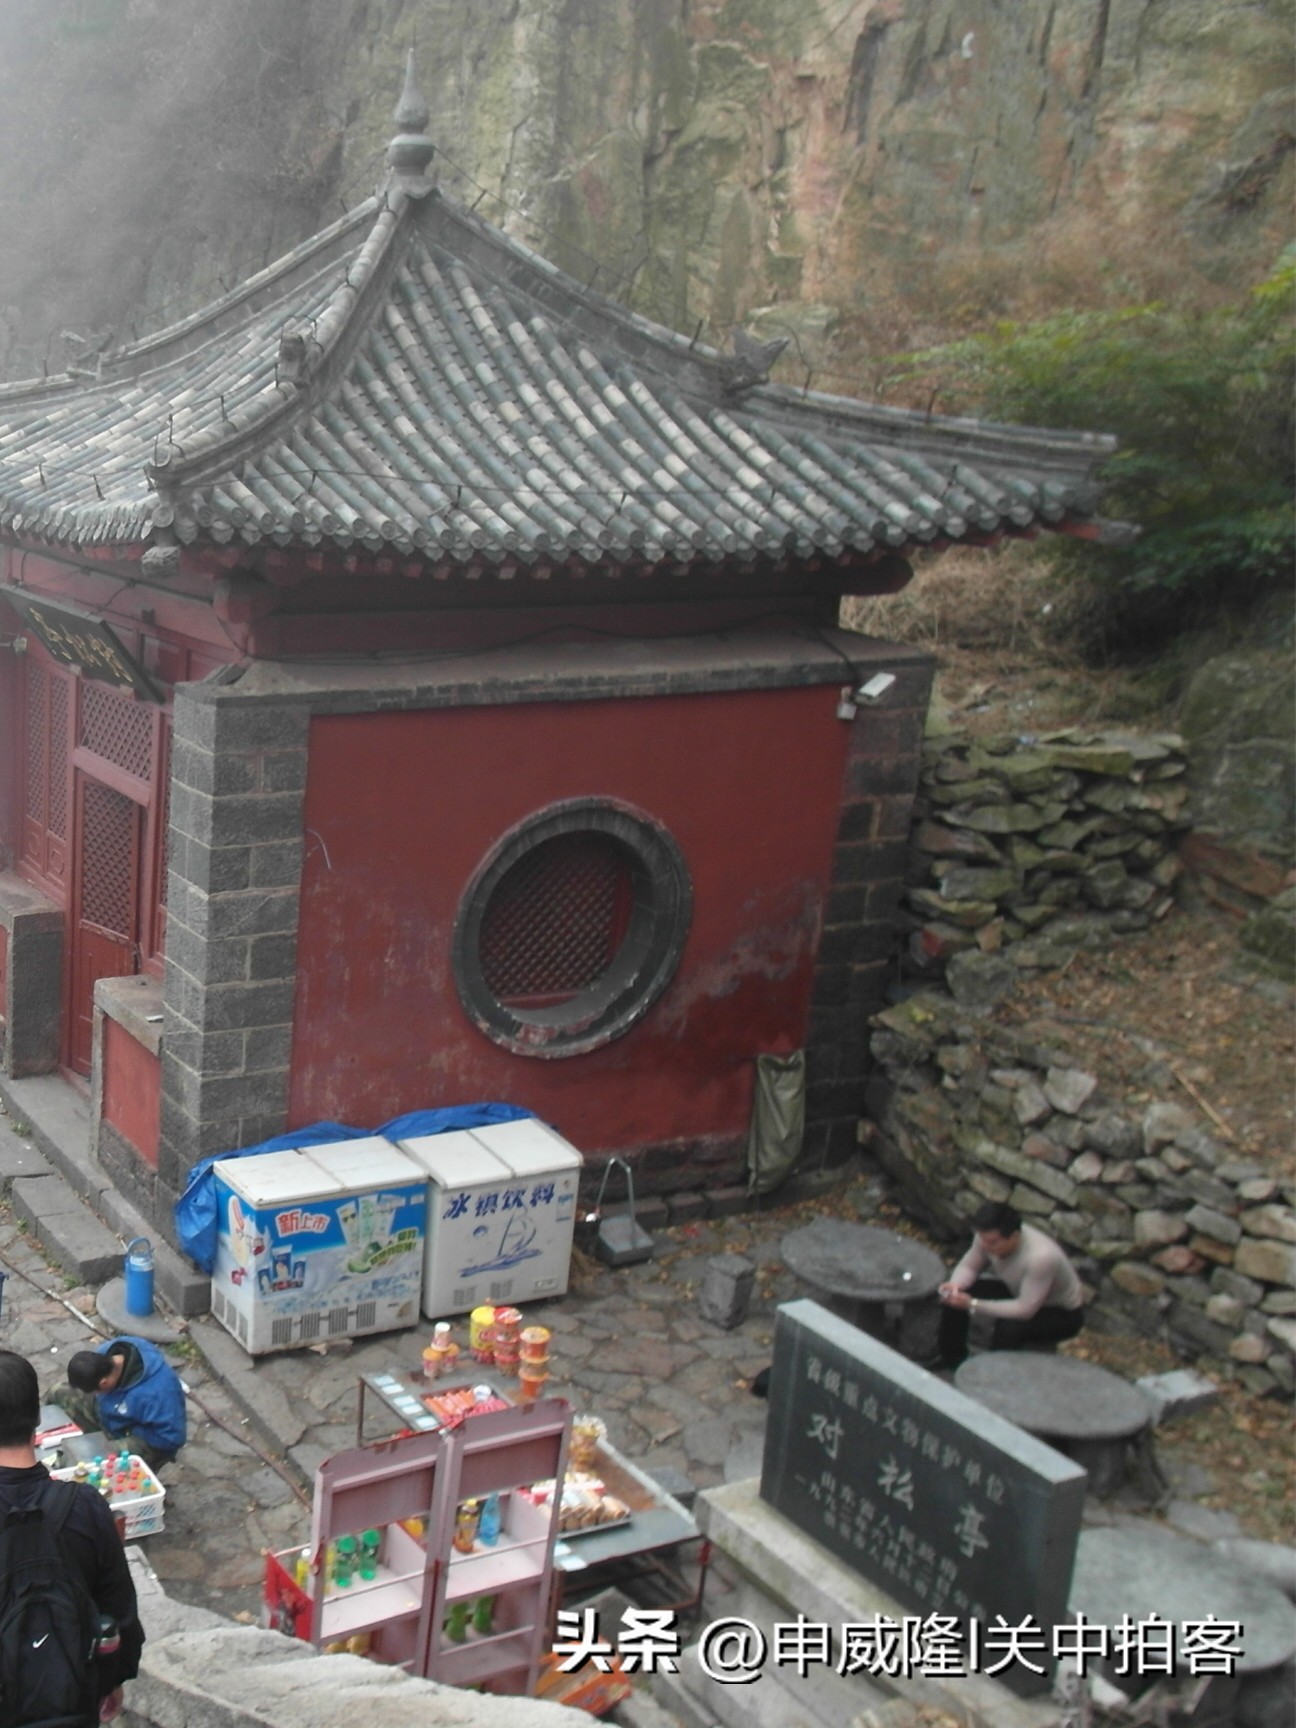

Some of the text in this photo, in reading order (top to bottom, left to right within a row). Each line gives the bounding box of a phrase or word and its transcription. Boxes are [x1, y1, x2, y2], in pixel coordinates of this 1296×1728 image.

[277, 1209, 328, 1236] 新上市
[805, 1411, 990, 1559] 对松亭
